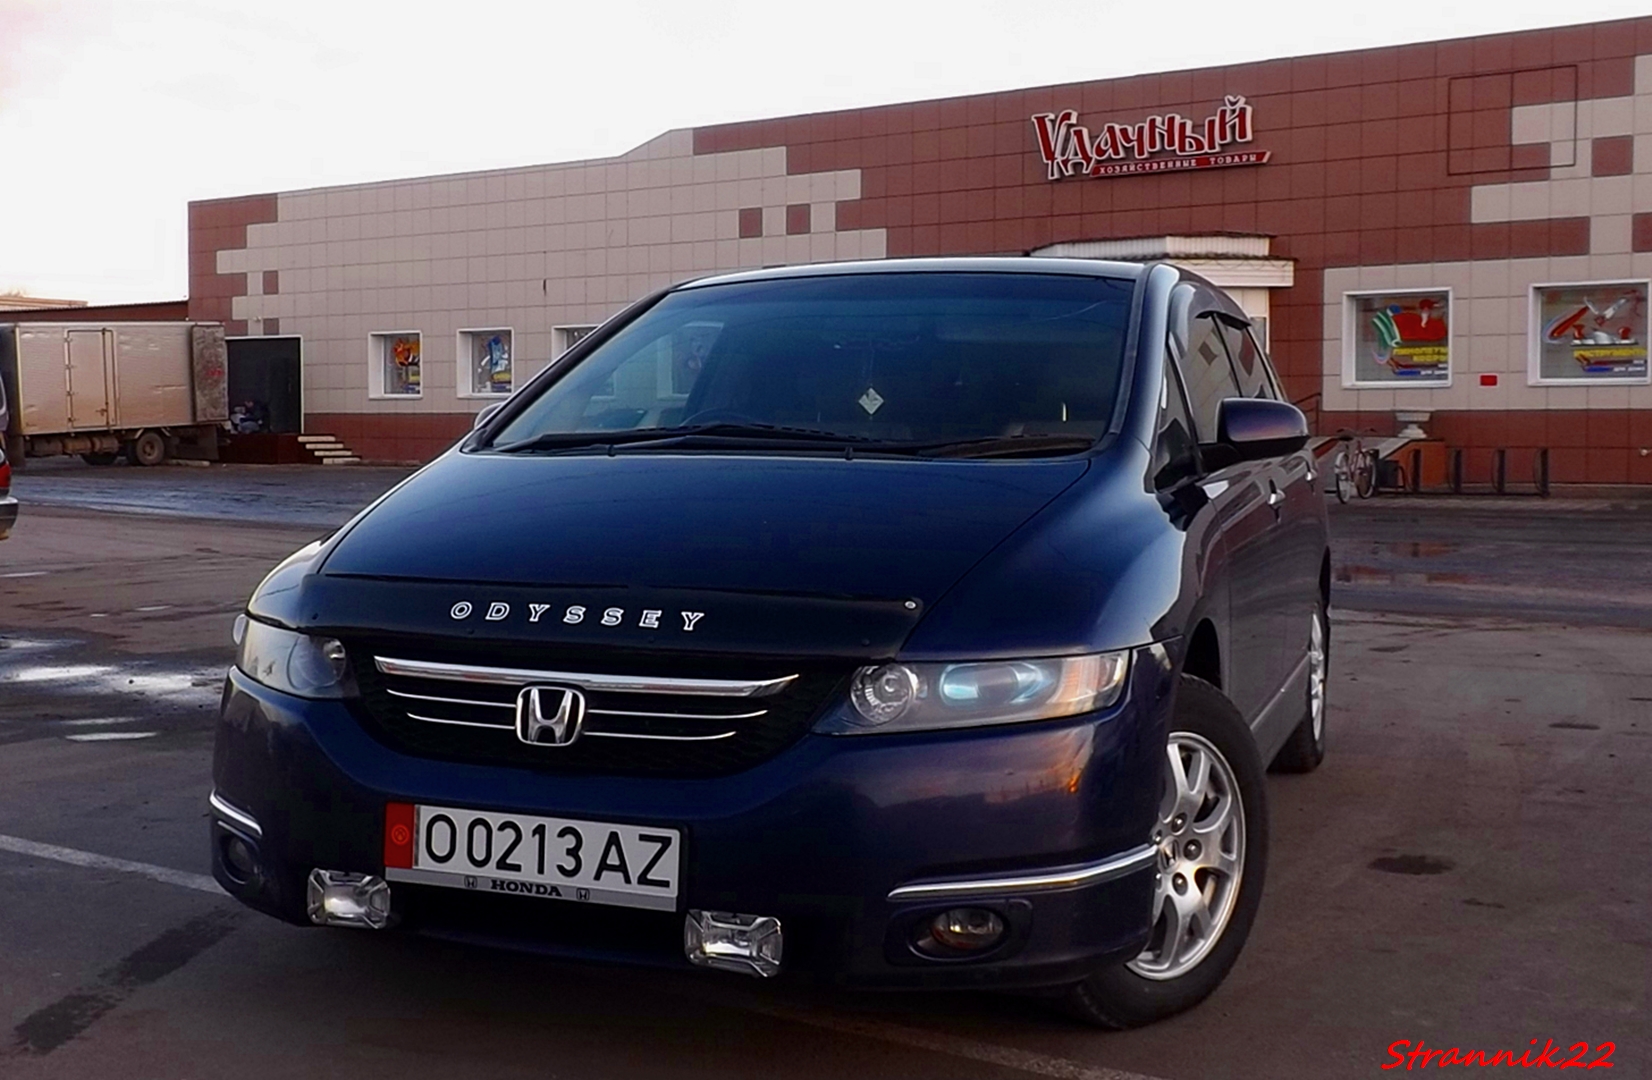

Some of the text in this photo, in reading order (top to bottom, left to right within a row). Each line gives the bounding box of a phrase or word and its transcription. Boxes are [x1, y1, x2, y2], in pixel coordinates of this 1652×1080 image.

[1031, 95, 1253, 179] Удачный
[1099, 154, 1257, 174] ХОЗЯЙСТВЕННЫЕ ТОВАРЫ
[450, 602, 704, 630] ODYSSEY
[490, 879, 563, 898] HONDA
